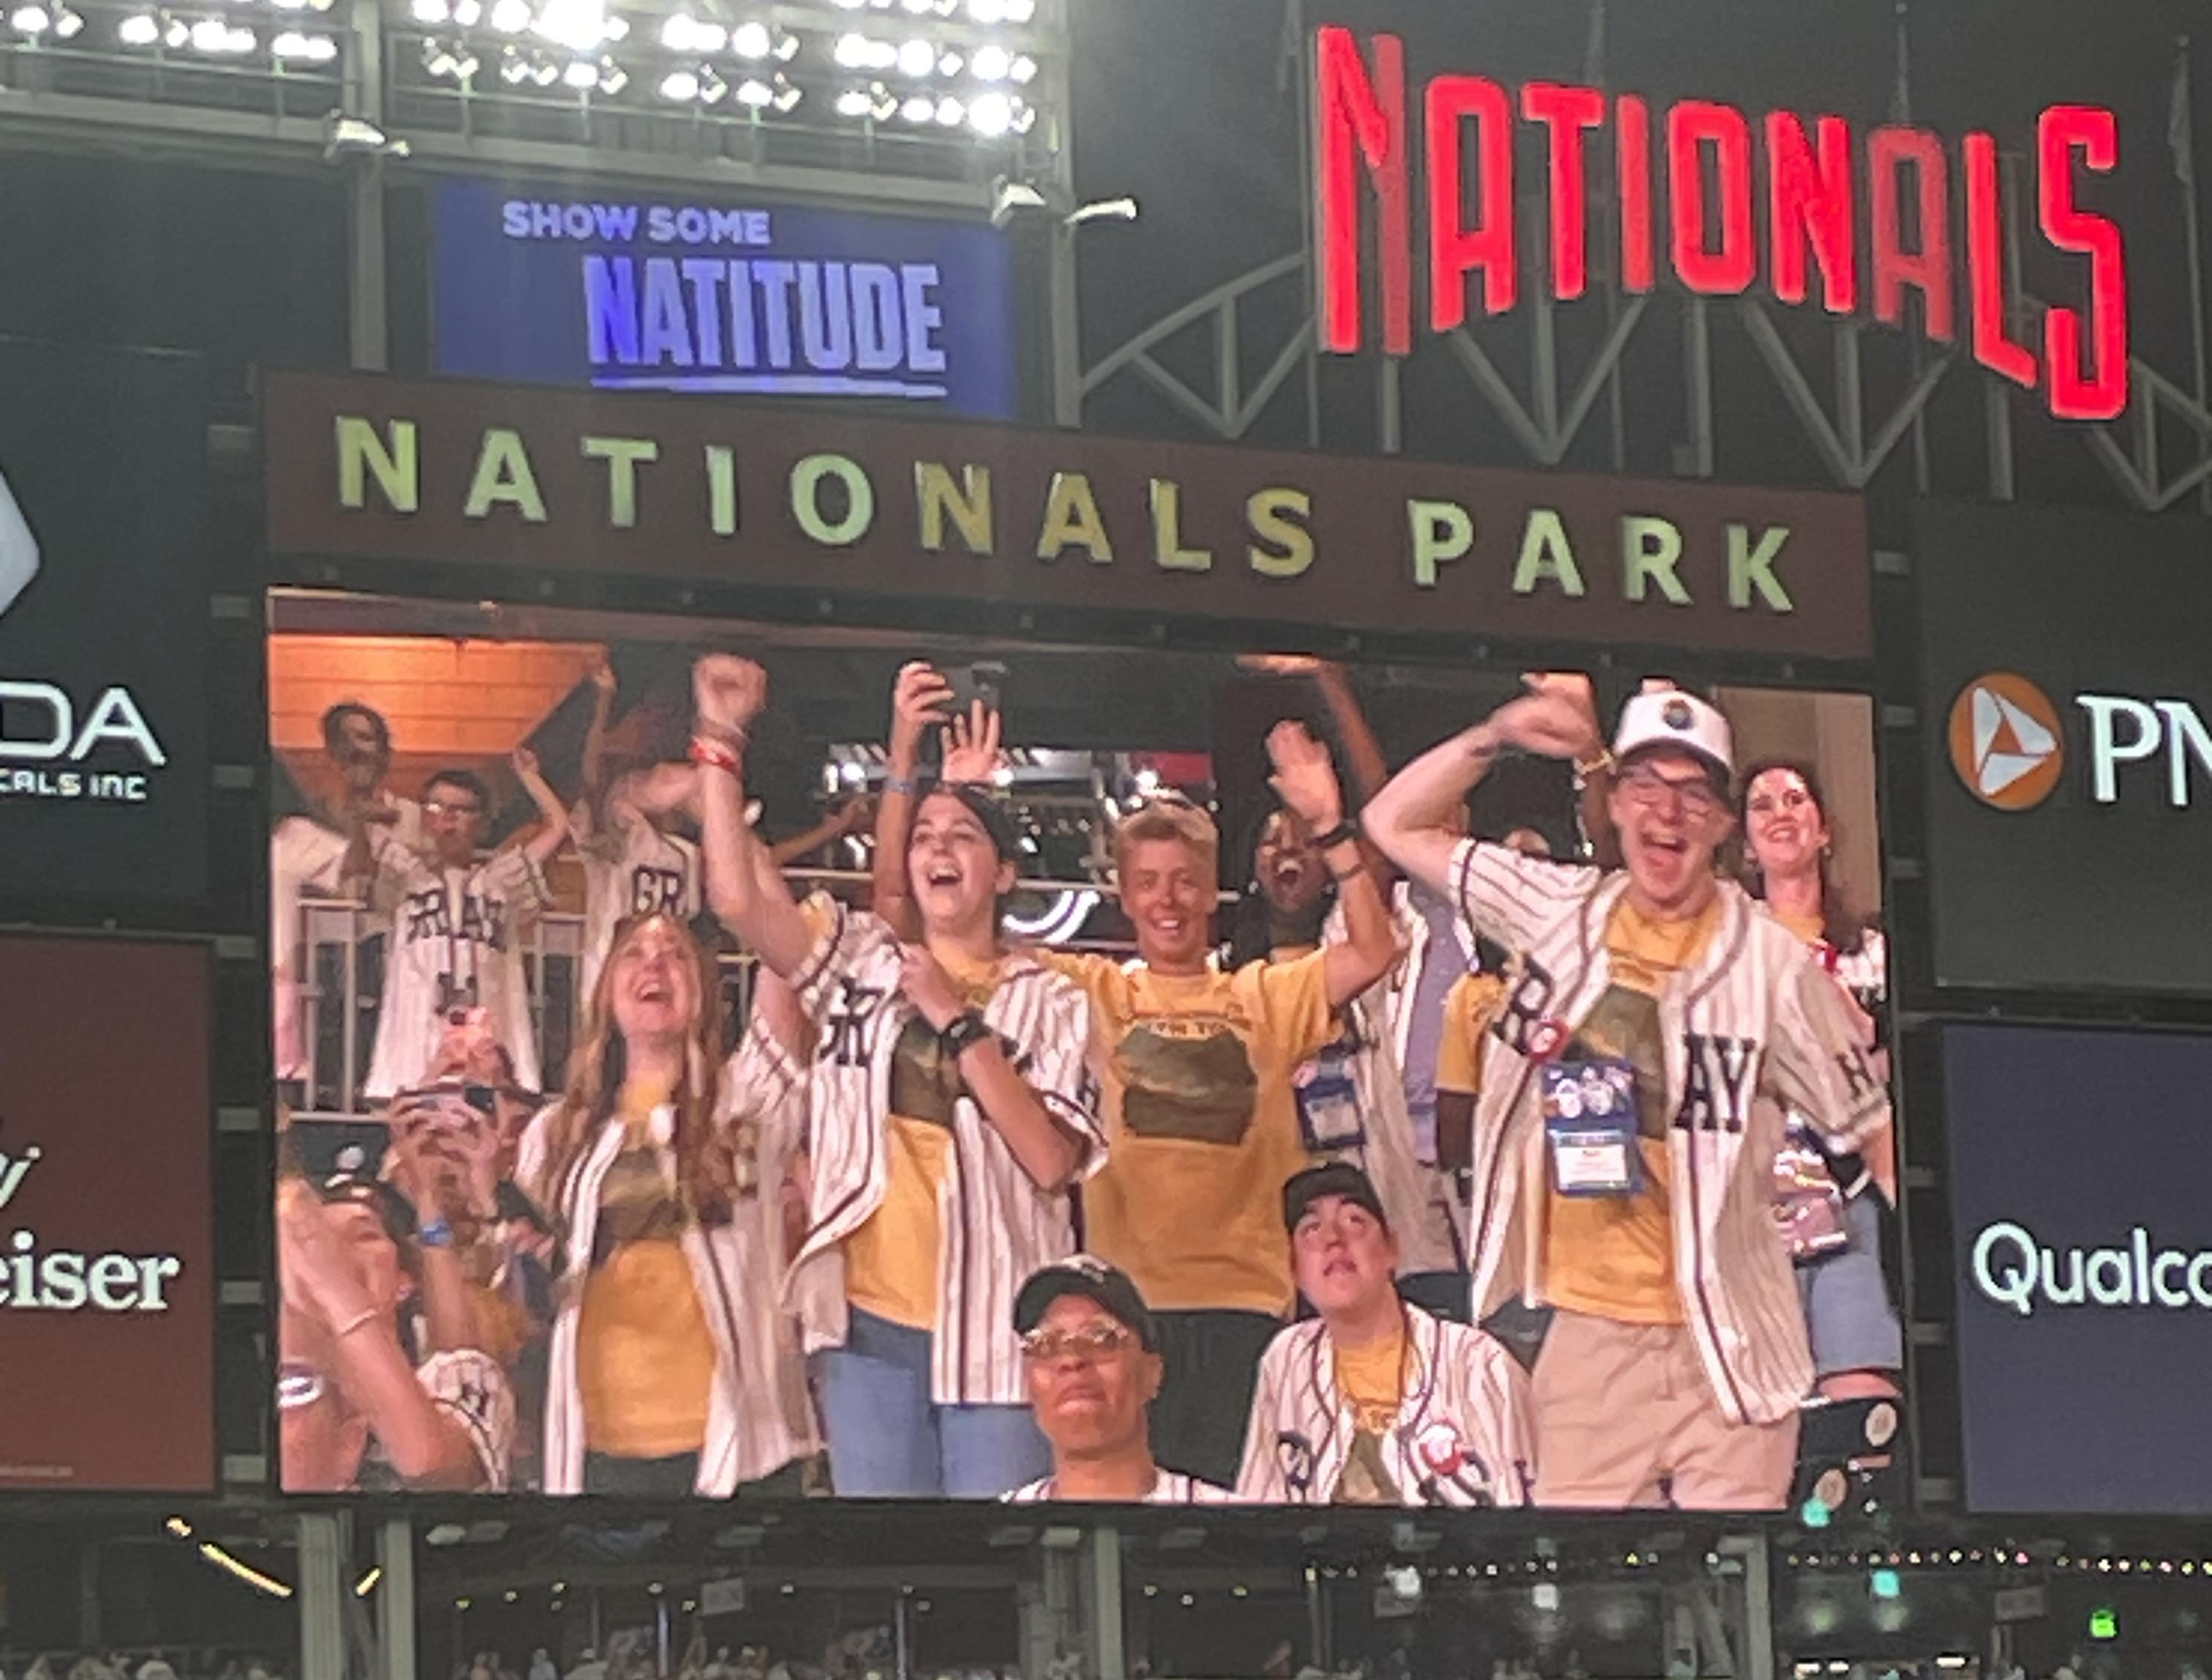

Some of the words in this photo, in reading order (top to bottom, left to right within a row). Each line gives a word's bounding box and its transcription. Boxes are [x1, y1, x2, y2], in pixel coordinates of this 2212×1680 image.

[503, 200, 638, 242] SHOW
[647, 206, 771, 246] SOME
[1317, 26, 2128, 419] NATIONALS
[583, 255, 947, 372] NATITUDE
[335, 415, 1314, 579] NATIONALS
[1408, 499, 1794, 612] PARK
[0, 1230, 181, 1309] iser
